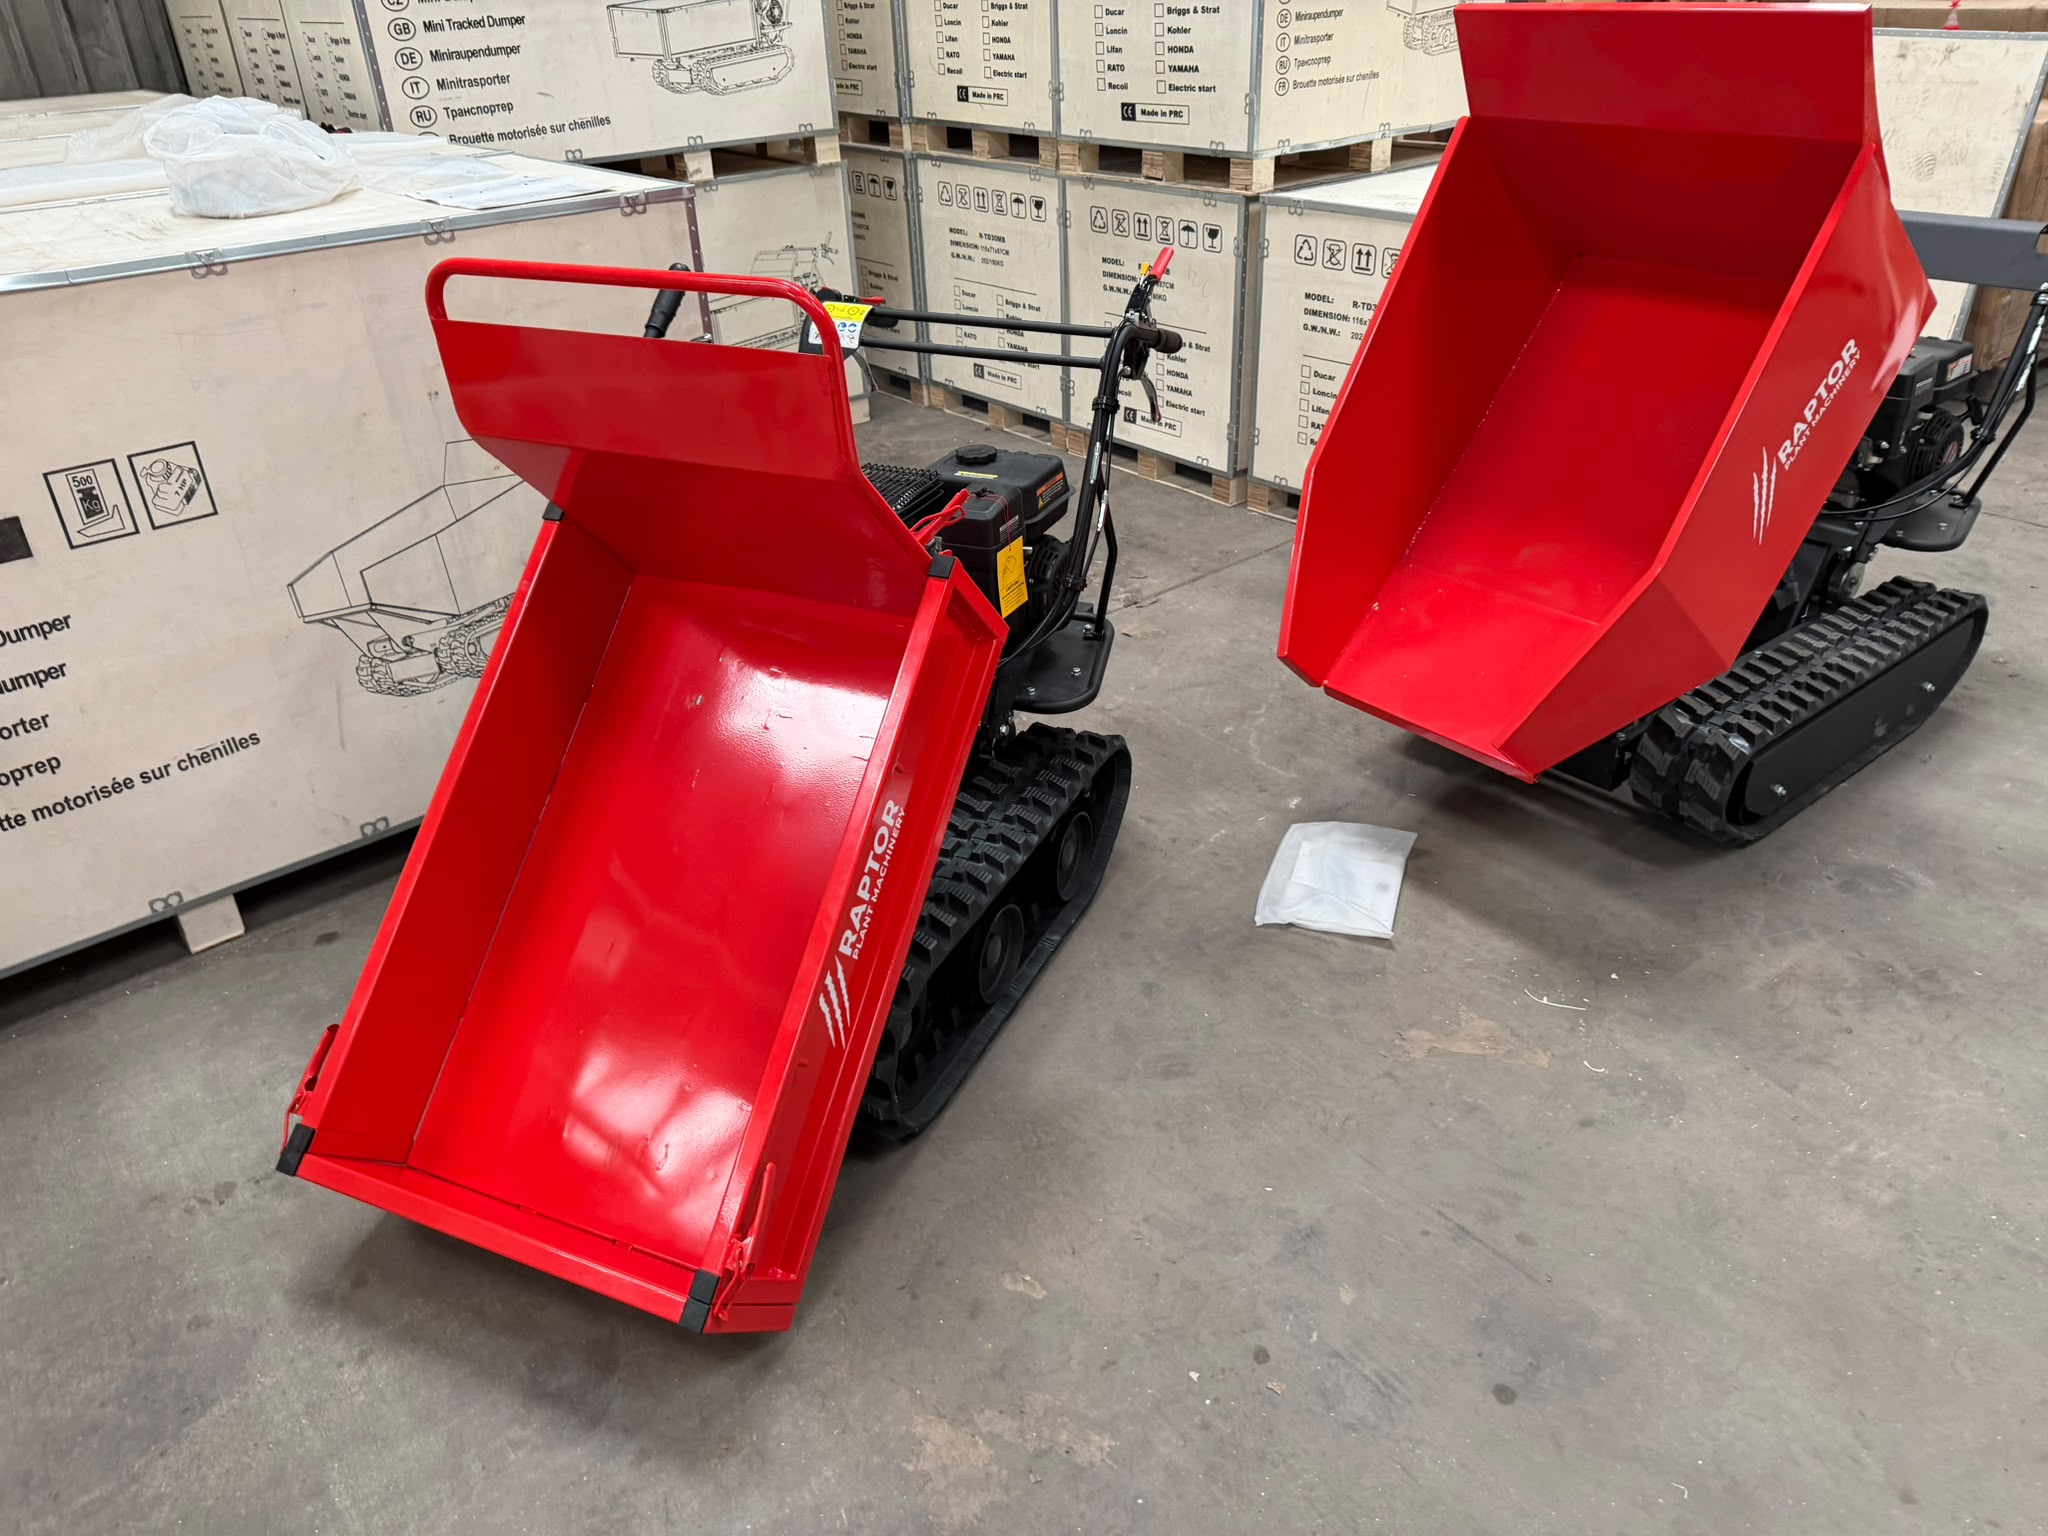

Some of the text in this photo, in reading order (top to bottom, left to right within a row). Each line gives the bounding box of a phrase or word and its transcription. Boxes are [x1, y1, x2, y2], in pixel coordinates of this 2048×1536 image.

[942, 2, 959, 10] Ducar
[990, 2, 1007, 11] Briggs
[1014, 2, 1028, 10] Strat
[1167, 5, 1220, 17] Briggs & Strat
[1105, 8, 1125, 16] Ducar
[1295, 8, 1344, 22] Miniraupendumper
[393, 14, 526, 36] GB Mini Tracked Dumper
[944, 19, 962, 27] Loncin
[991, 19, 1009, 27] Kohler
[1106, 27, 1128, 35] Loncin
[1167, 26, 1192, 34] Kohler
[945, 34, 958, 43] Lifan
[992, 36, 1011, 44] HONDA
[1294, 32, 1334, 45] Minitrasporter
[400, 43, 521, 65] DE Miniraupendumper
[1106, 45, 1123, 54] Lifan
[1167, 45, 1194, 54] HONDA
[945, 51, 960, 59] RATO
[992, 53, 1015, 61] YAMAHA
[946, 67, 963, 75] Recoil
[1107, 63, 1125, 72] RATO
[1168, 65, 1199, 73] YAMAHA
[993, 70, 1027, 79] Electric start
[1293, 78, 1317, 90] Brouette
[1346, 74, 1355, 83] sur
[1356, 69, 1379, 82] chenilles
[409, 72, 511, 95] IT Minitrasporter
[1108, 82, 1129, 90] Recoil
[1168, 83, 1216, 93] Electric start
[972, 91, 986, 99] Made
[993, 93, 1004, 101] PRC
[415, 100, 514, 124] RU Транспортер
[1141, 108, 1184, 118] Made in PRC
[449, 115, 611, 146] Brouette motorisée sur chenilles
[1101, 256, 1125, 266] MODEL:
[1102, 270, 1138, 282] DIMENSION:
[1005, 299, 1021, 309] Briggs
[1304, 291, 1377, 312] MODEL: R-TD3
[1303, 307, 1351, 322] DIMENSION:
[1303, 323, 1364, 341] G.W./N.W.: 202
[1007, 342, 1028, 352] YAMAHA
[1195, 343, 1211, 353] Strat
[1166, 354, 1187, 364] Kohler
[1166, 368, 1189, 380] HONDA
[1313, 370, 1336, 381] Ducar
[1166, 384, 1193, 398] YAMAHA
[1312, 387, 1338, 399] Loncin
[1777, 338, 1858, 465] RAPTOR
[1165, 400, 1206, 416] Electric start
[1311, 404, 1330, 415] Lifan
[1784, 349, 1861, 471] PLANT MACHINERY
[1164, 423, 1177, 431] PRC
[72, 474, 94, 488] 500
[84, 498, 101, 512] Kg
[31, 776, 136, 822] motorisée
[139, 762, 172, 785] sur
[176, 732, 261, 773] chenilles
[838, 799, 900, 958] RAPTOR
[852, 808, 906, 961] PLANT MACHINERY
